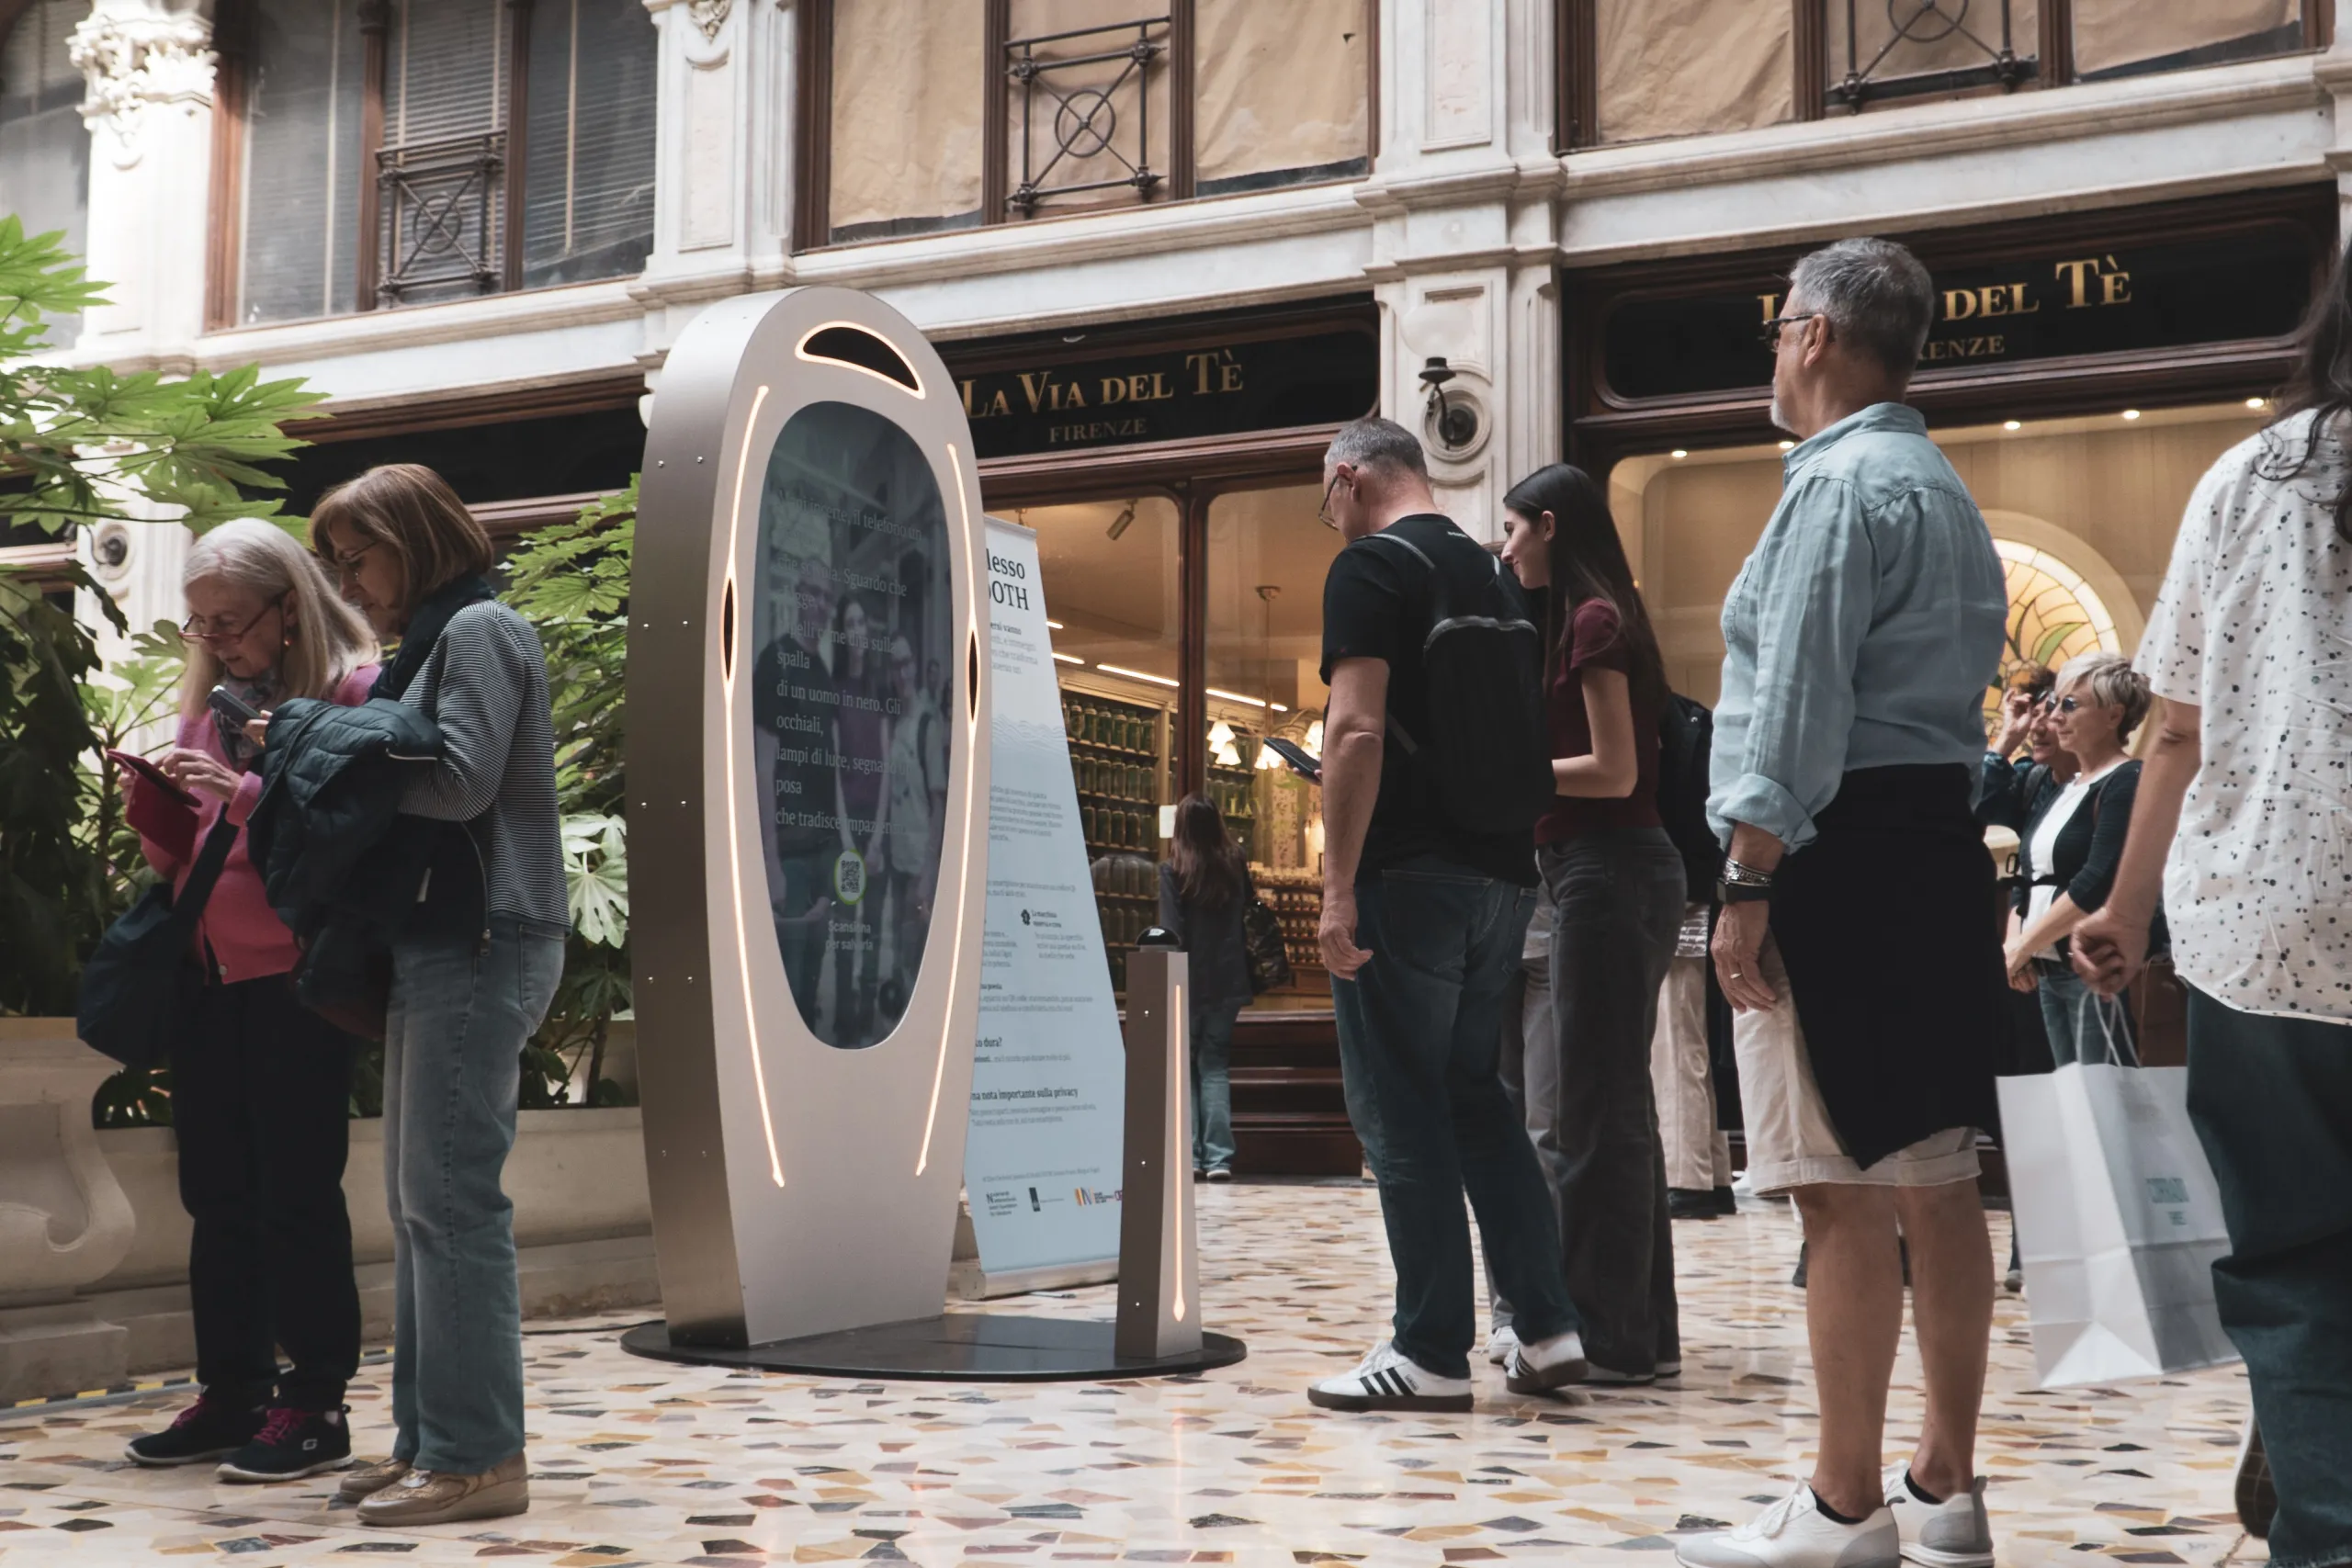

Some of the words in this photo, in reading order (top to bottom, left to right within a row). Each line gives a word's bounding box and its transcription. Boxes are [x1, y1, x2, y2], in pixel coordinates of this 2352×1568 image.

[1942, 282, 2040, 321] DEL
[2055, 254, 2132, 310] TÈ
[1100, 372, 1174, 405] DEL
[1186, 348, 1244, 395] TÈ
[1049, 417, 1147, 443] FIRENZE
[864, 513, 907, 537] telefono
[844, 567, 888, 591] Sguardo
[888, 579, 908, 596] che
[777, 649, 810, 669] spalla
[776, 679, 788, 697] di
[791, 685, 806, 699] un
[808, 688, 840, 705] uomo
[842, 690, 854, 706] in
[855, 697, 883, 712] nero.
[886, 697, 901, 715] Gli
[776, 713, 825, 735] occhiali,
[777, 746, 808, 766] lampi
[811, 748, 823, 765] di
[825, 749, 851, 771] luce,
[776, 779, 802, 795] posa
[775, 807, 796, 825] che
[798, 810, 842, 830] tradisce
[998, 1088, 1035, 1101] importante
[1036, 1088, 1053, 1099] sulla
[1054, 1086, 1078, 1100] privacy
